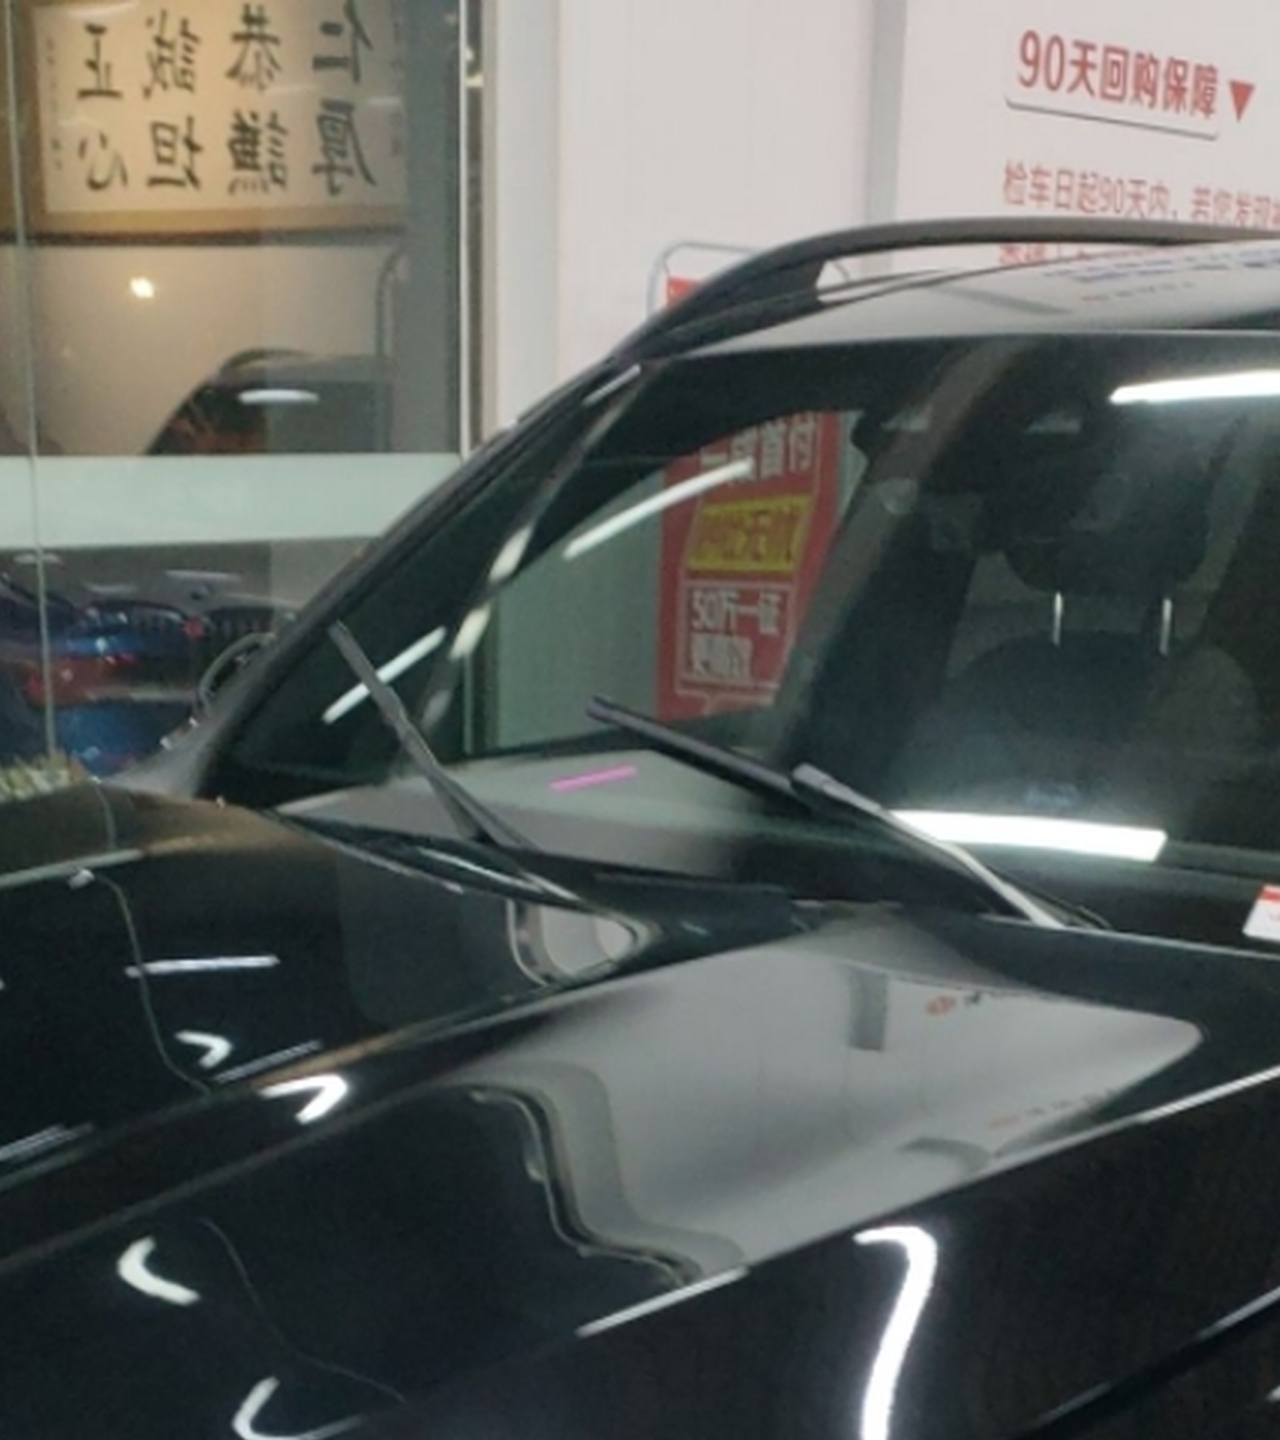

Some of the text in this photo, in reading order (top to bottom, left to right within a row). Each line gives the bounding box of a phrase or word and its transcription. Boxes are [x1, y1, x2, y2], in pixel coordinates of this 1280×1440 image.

[1017, 28, 1219, 119] 90天回购保障
